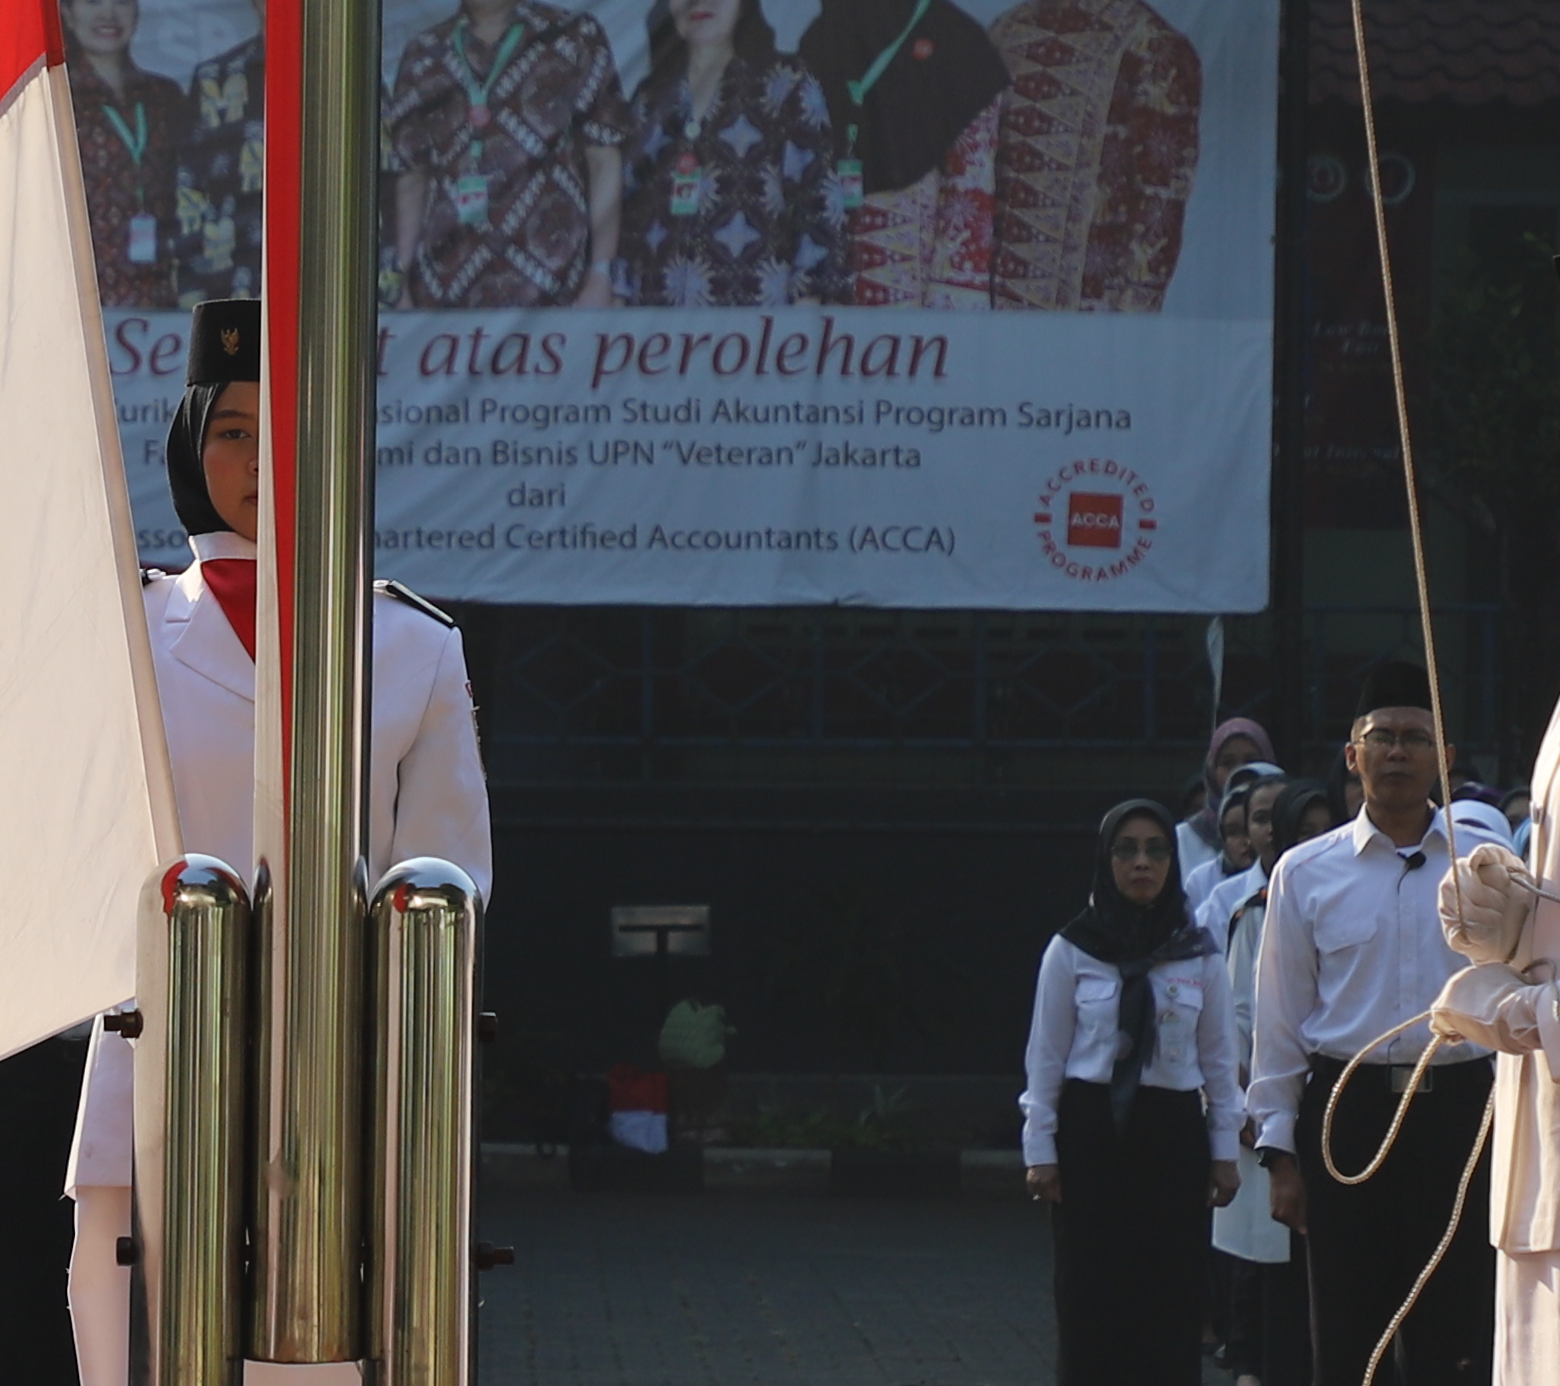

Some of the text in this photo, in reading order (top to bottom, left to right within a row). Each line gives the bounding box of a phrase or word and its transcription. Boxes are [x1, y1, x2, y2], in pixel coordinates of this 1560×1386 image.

[419, 326, 568, 377] atas
[590, 315, 949, 391] perolehan
[481, 398, 611, 430] Program
[623, 397, 702, 424] Studi
[711, 399, 865, 425] Akuntansi
[874, 400, 1007, 433] Program
[1018, 402, 1133, 436] Sarjana
[424, 440, 480, 464] dan
[493, 440, 578, 465] Bisnis
[589, 440, 655, 465] UPN
[812, 442, 921, 468] Jakarta
[508, 481, 567, 508] dari
[1039, 459, 1155, 512] ACCREDITED
[1071, 512, 1120, 528] ACCA
[506, 523, 638, 550] Certified
[649, 524, 838, 552] Accountants
[849, 525, 956, 557] (ACCA)
[1037, 530, 1153, 581] PROGRAMME
